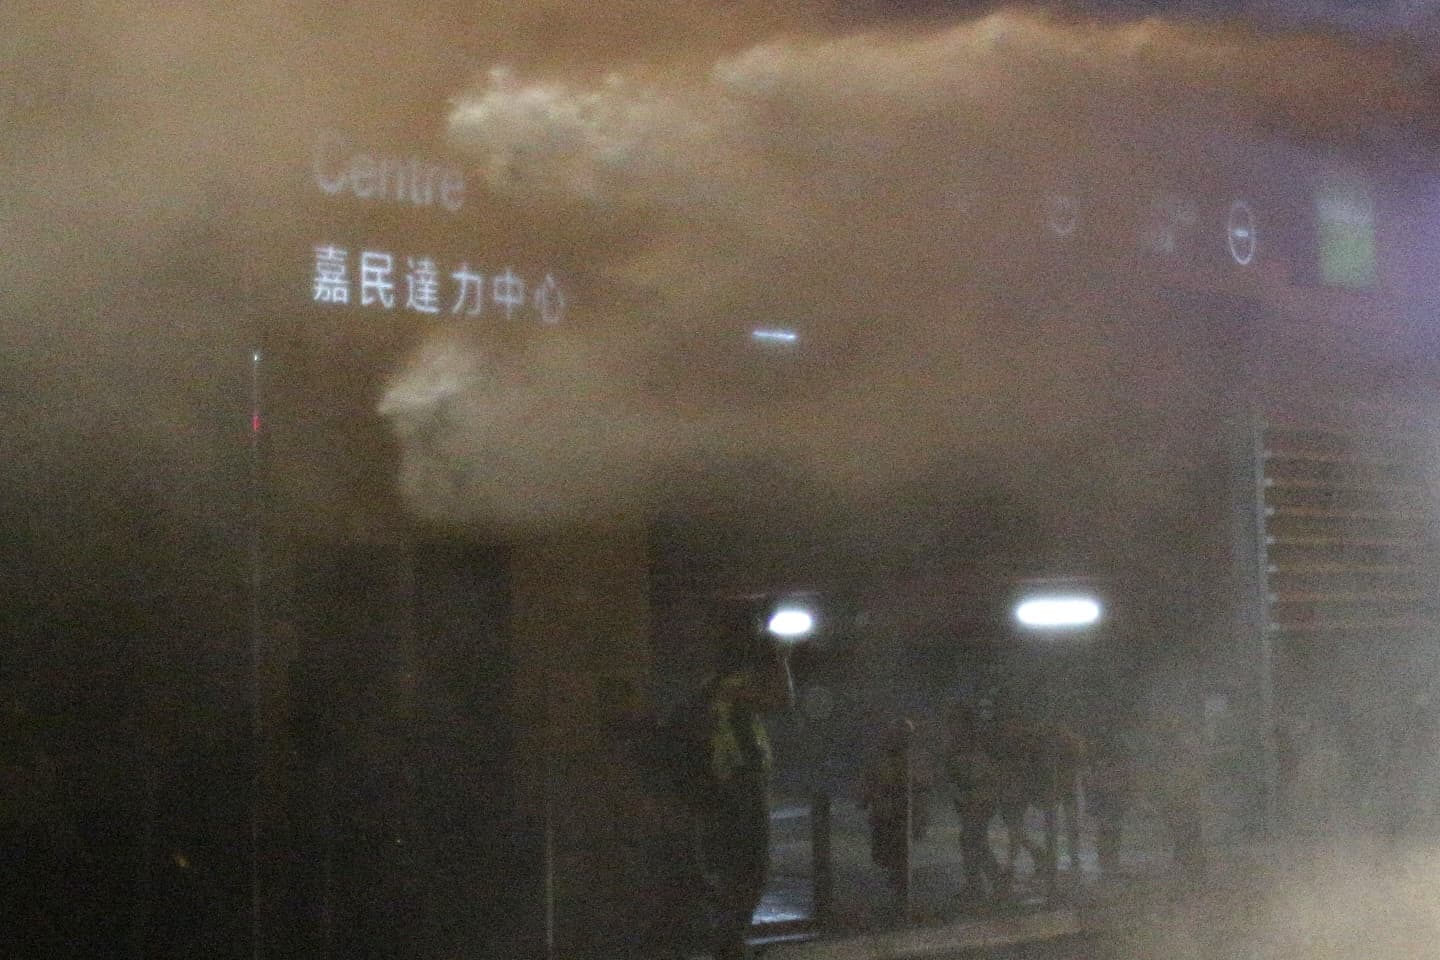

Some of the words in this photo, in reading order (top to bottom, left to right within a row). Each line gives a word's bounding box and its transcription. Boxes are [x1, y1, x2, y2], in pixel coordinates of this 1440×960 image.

[312, 244, 566, 325] 嘉民達力中心
